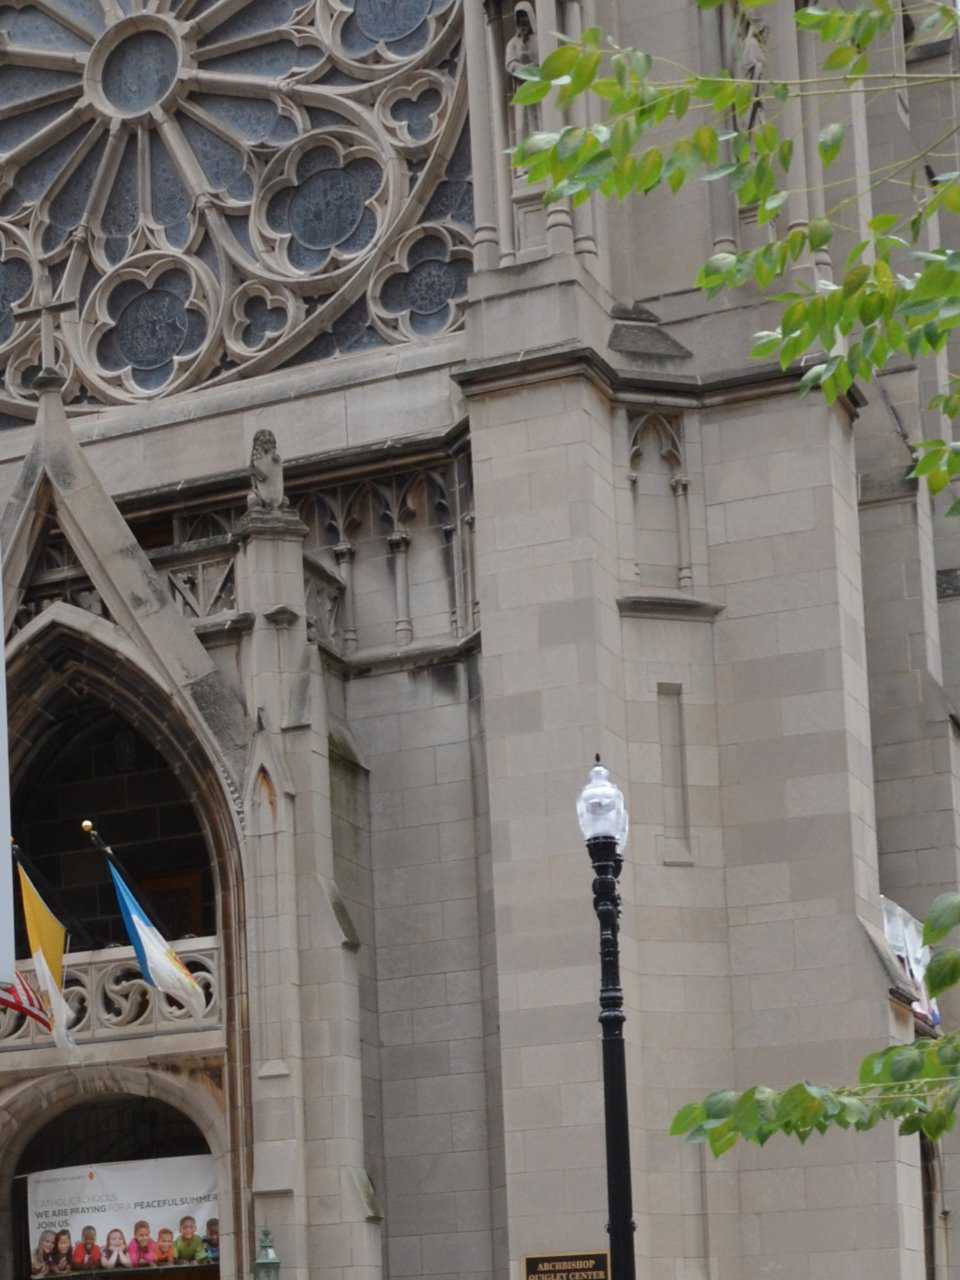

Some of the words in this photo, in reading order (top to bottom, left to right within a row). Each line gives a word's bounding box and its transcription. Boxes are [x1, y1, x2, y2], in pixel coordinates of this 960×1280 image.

[133, 1198, 180, 1210] PEACEFUL
[36, 1221, 56, 1230] JOIN
[57, 1219, 70, 1228] US
[536, 1259, 596, 1272] ARCHBISHOP
[568, 1270, 606, 1280] CENTER
